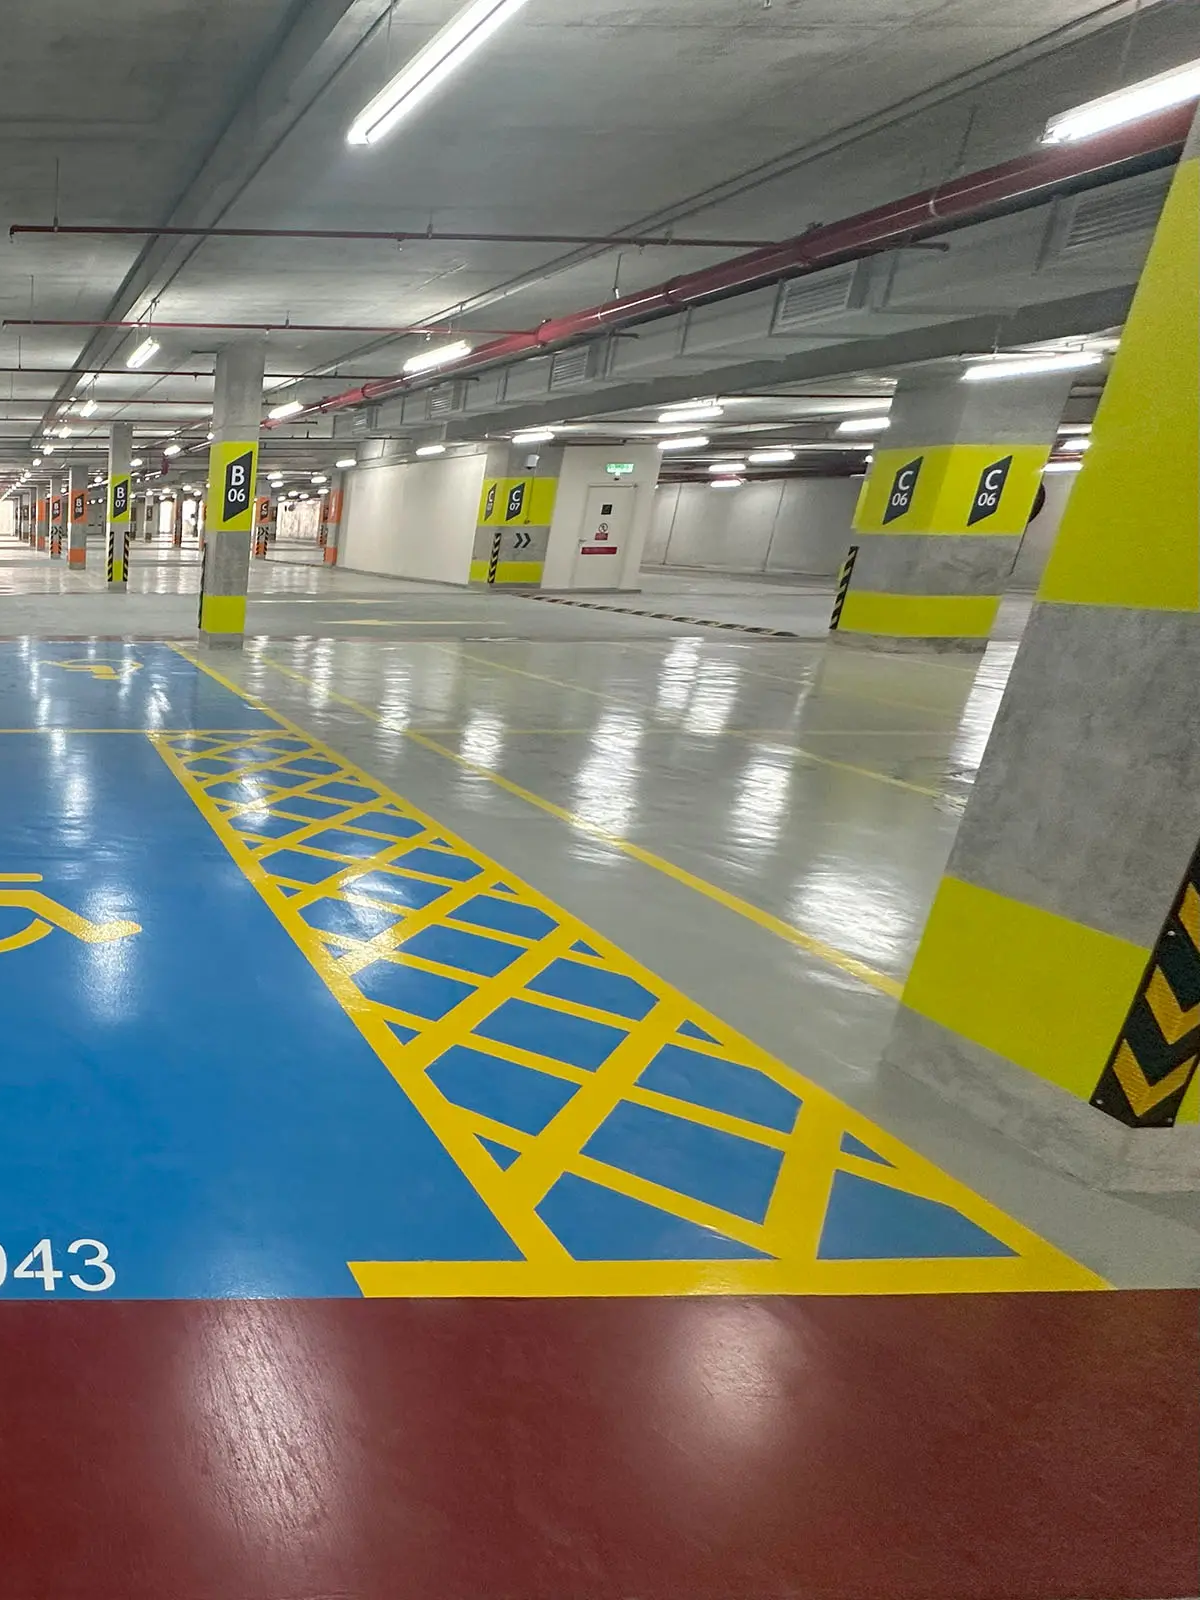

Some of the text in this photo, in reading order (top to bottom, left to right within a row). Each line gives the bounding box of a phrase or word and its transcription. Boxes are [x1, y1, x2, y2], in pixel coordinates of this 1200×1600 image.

[231, 465, 245, 486] B
[899, 470, 914, 491] C
[984, 469, 1003, 490] C
[116, 487, 125, 499] B
[228, 488, 246, 503] 06
[512, 490, 521, 502] C
[891, 493, 908, 506] 06
[115, 500, 126, 508] 07
[509, 502, 521, 511] 07
[977, 493, 996, 507] 06
